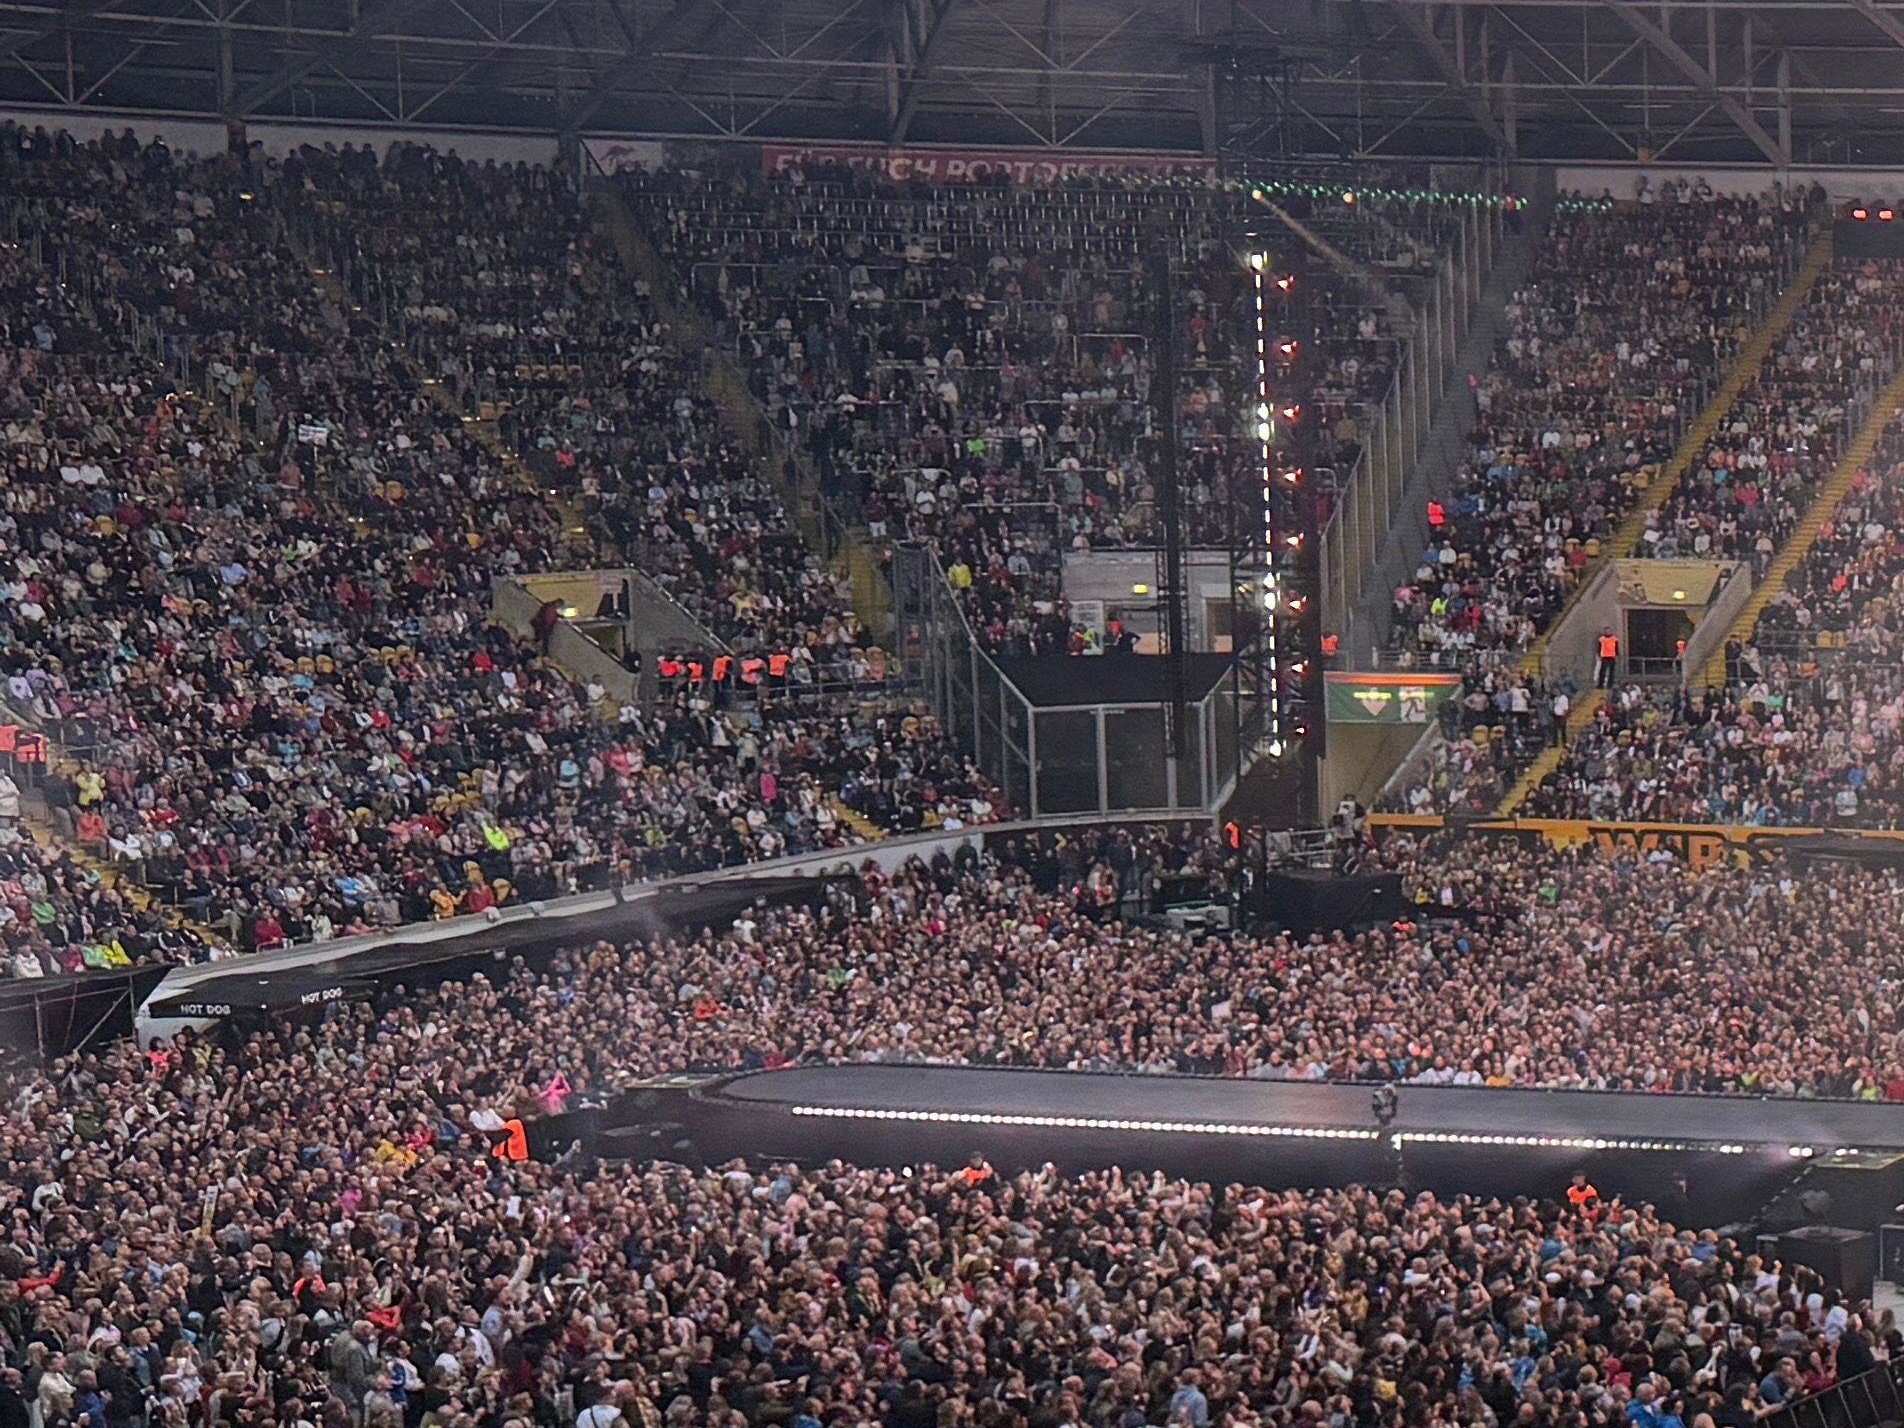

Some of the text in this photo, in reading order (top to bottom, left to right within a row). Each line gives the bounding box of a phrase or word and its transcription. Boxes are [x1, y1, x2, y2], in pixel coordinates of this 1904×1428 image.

[301, 987, 343, 1004] HOT DOG
[180, 1004, 231, 1015] HOT DOG
